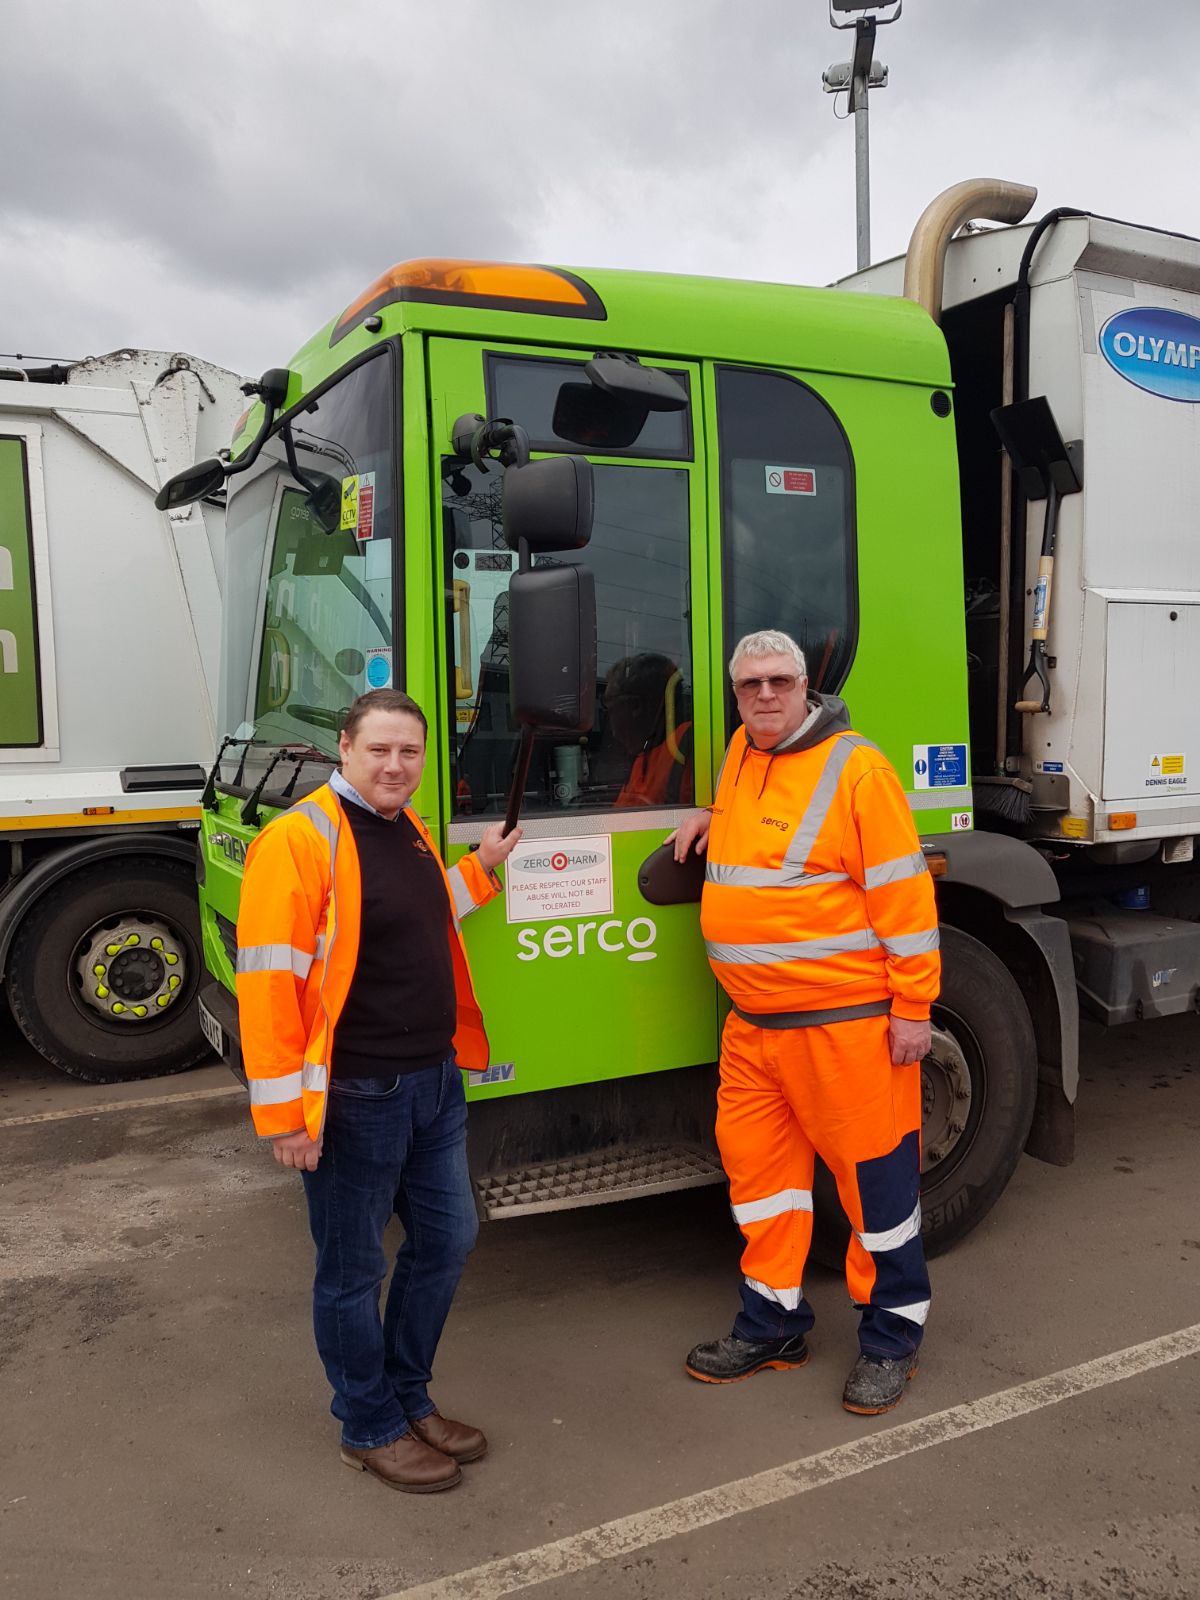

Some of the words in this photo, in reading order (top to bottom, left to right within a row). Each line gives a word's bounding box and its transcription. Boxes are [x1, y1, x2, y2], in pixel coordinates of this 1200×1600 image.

[342, 509, 356, 521] CCTV
[761, 816, 789, 831] serco
[523, 857, 550, 868] ZERO
[567, 854, 597, 865] HARM
[512, 883, 537, 891] PLEASE
[539, 880, 569, 889] RESPECT
[570, 879, 586, 887] OUR
[587, 877, 607, 885] STAFF
[526, 893, 549, 901] ABUSE
[550, 891, 567, 899] WILL
[568, 889, 584, 898] NOT
[585, 888, 594, 896] BE
[541, 901, 581, 910] TOLERATED
[516, 917, 657, 961] serco
[481, 1063, 513, 1083] EEV
